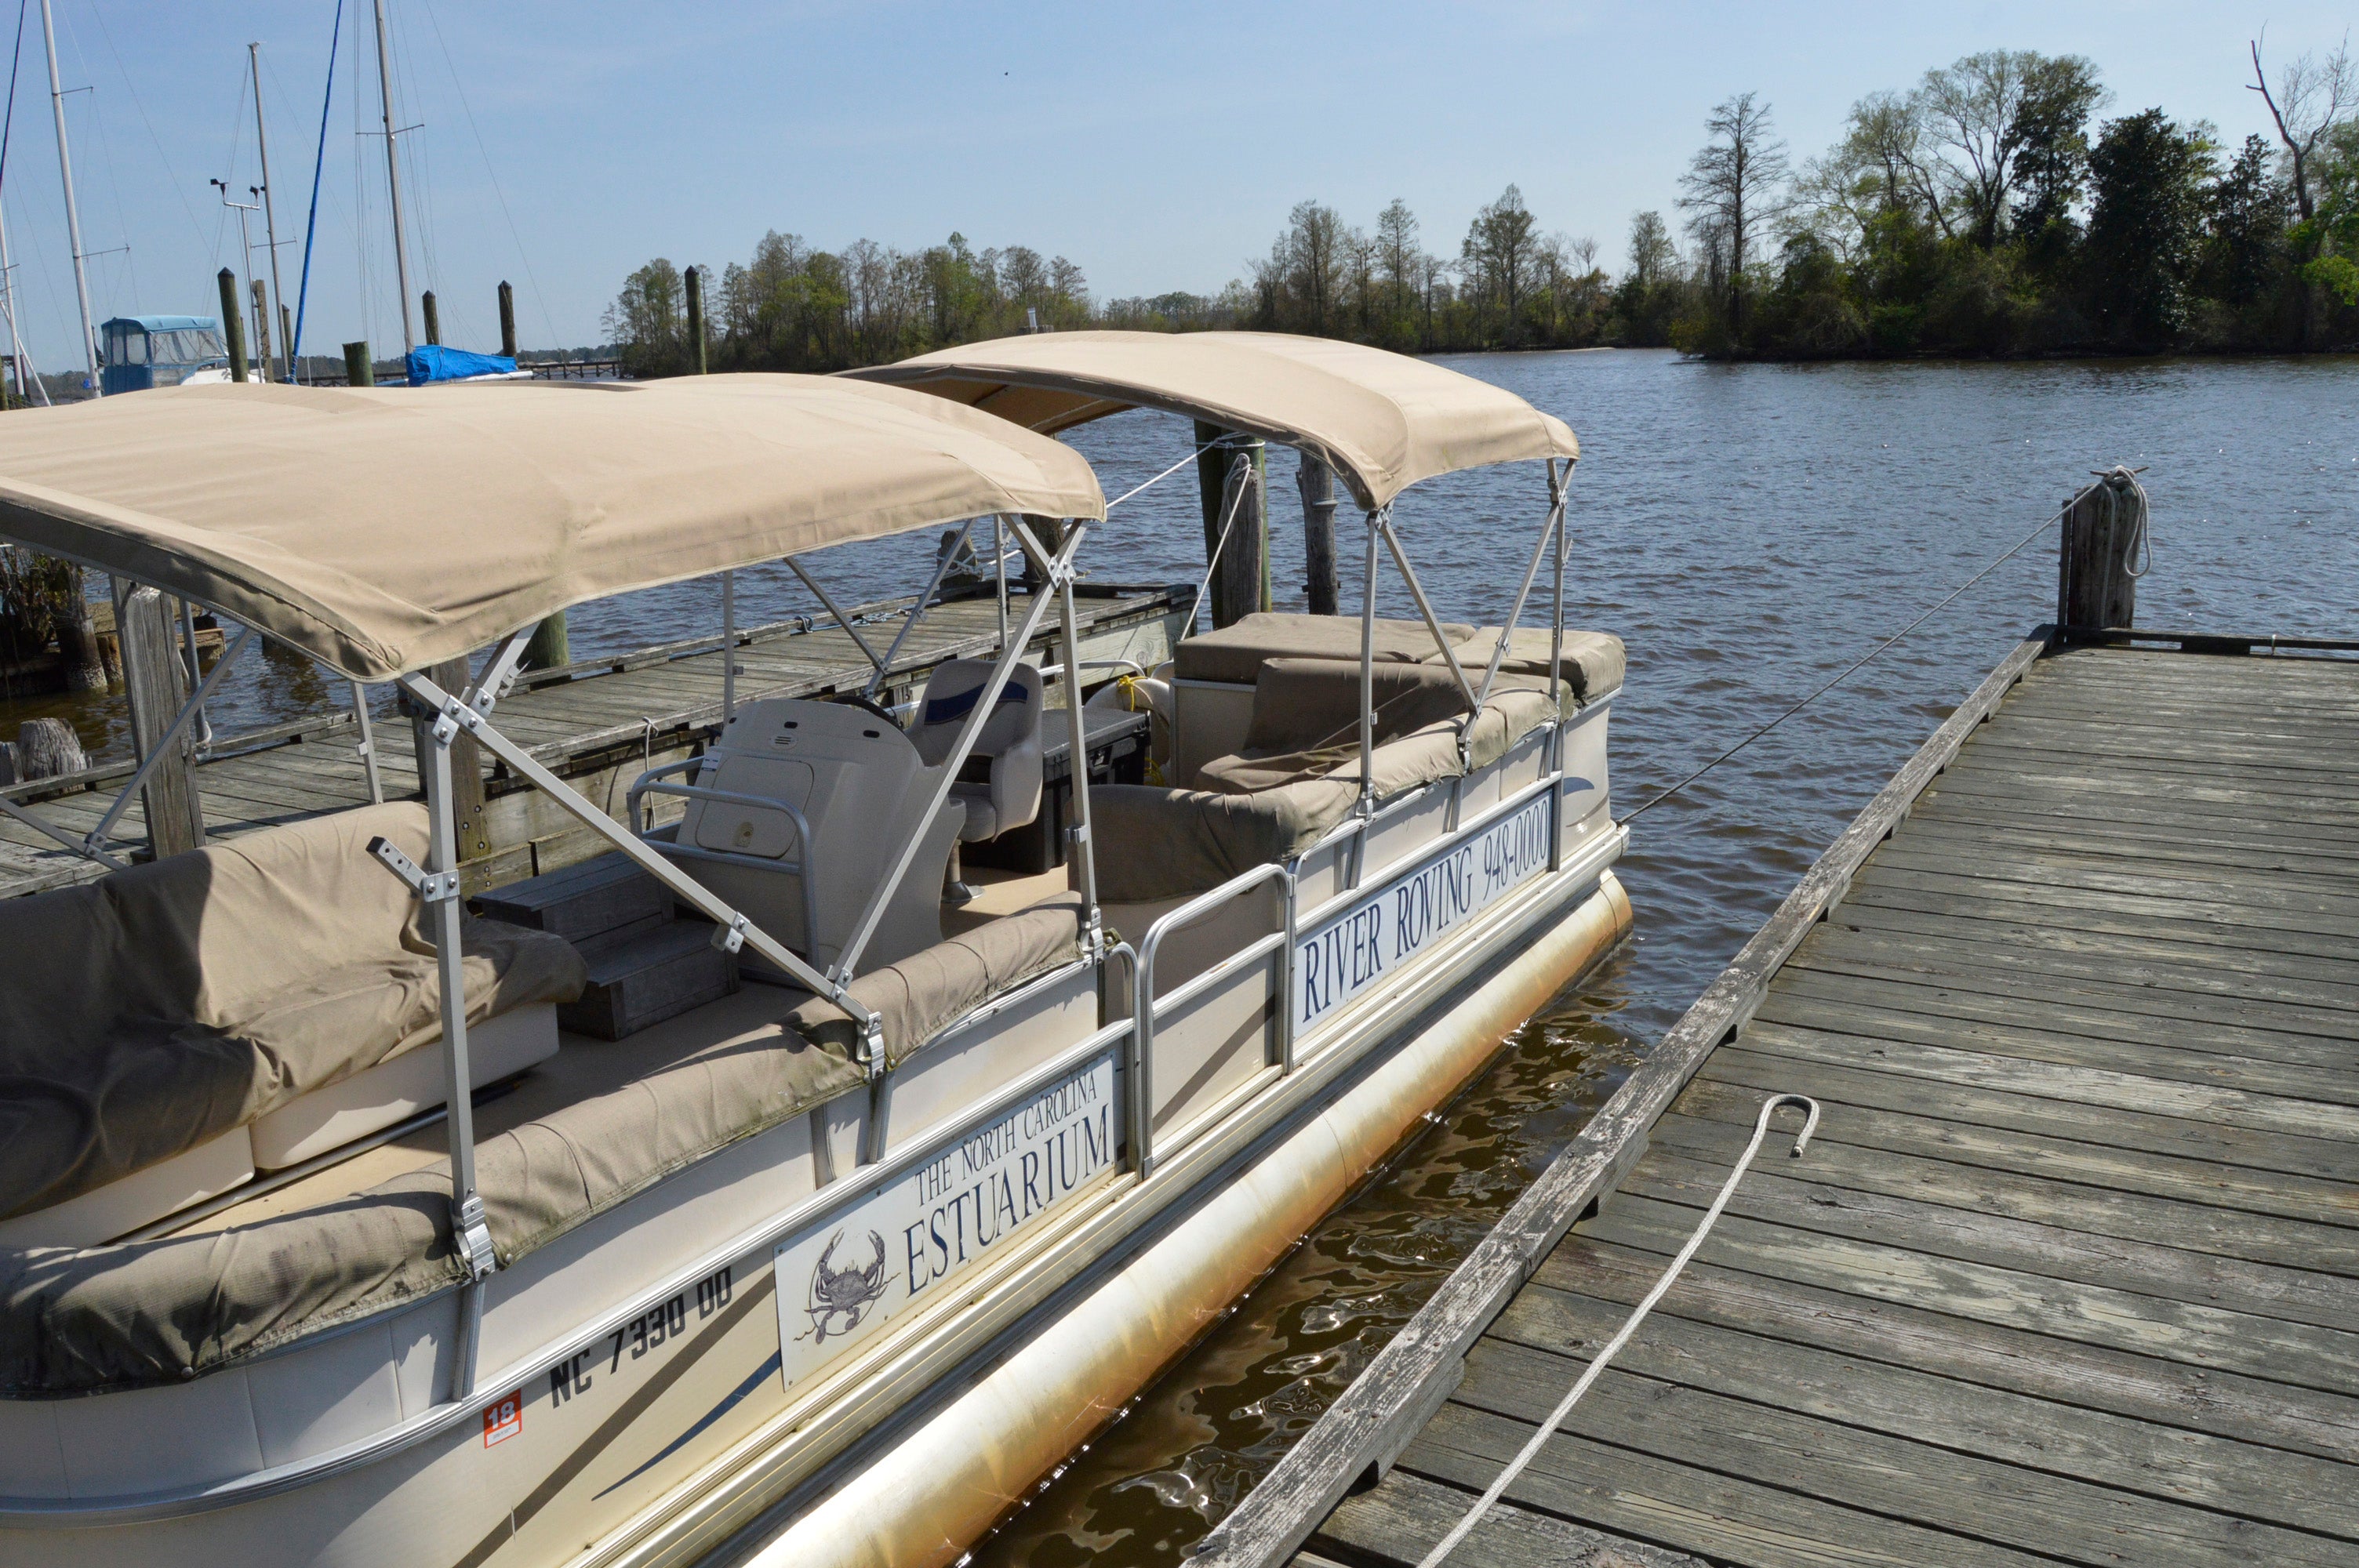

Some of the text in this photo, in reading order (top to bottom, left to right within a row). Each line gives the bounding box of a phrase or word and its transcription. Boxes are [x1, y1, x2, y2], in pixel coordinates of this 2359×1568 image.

[1303, 800, 1548, 1023] RIVER ROVING 948-0000
[903, 1102, 1110, 1298] ESTUARIUM
[915, 1070, 1097, 1207] THE NORTH CAROLINA
[488, 1401, 515, 1430] 18
[550, 1348, 592, 1409] NC
[608, 1293, 685, 1375] 7330
